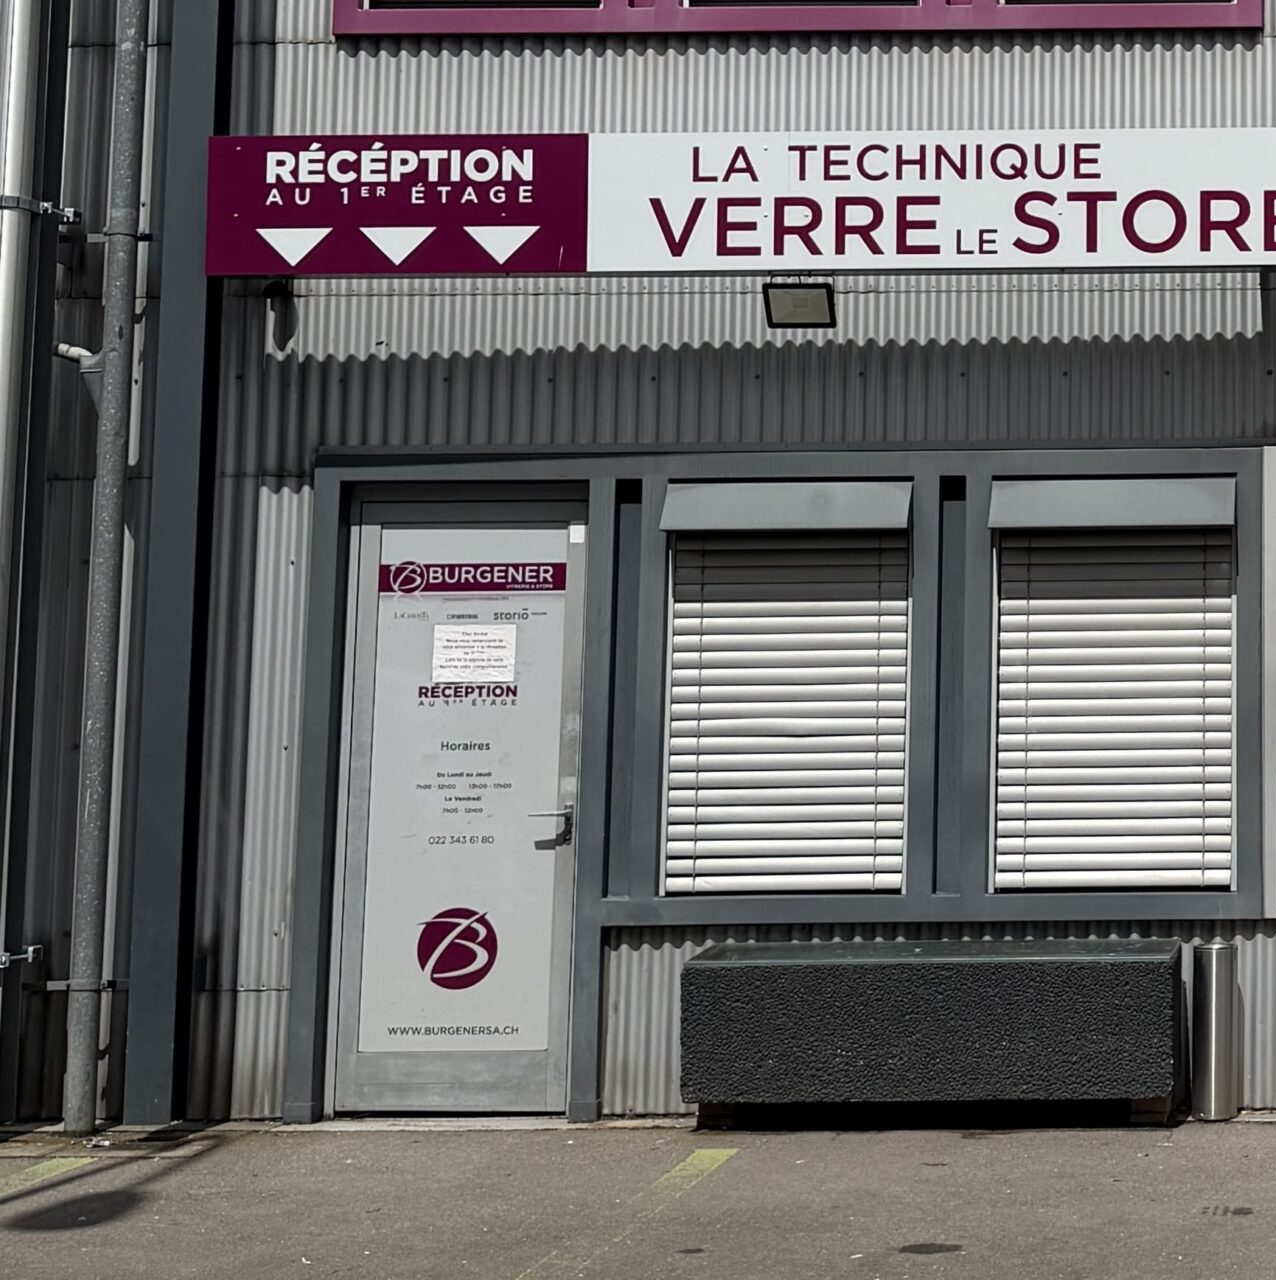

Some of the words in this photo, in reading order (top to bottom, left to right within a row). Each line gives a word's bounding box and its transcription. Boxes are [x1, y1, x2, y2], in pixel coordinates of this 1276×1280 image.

[265, 141, 534, 185] RÉCÉPTION
[691, 145, 760, 184] LA
[786, 142, 1102, 182] TECHNIQUE
[264, 186, 312, 206] AU
[410, 182, 534, 205] ÉTAGE
[647, 195, 942, 258] VERRE
[955, 228, 999, 255] LE
[428, 565, 554, 584] BURGENER
[440, 741, 491, 751] Horaires
[428, 836, 447, 845] 022
[449, 835, 467, 844] 343
[469, 835, 480, 844] 61
[481, 835, 495, 844] 80
[387, 1026, 519, 1036] WWW.BURGENERSA.CH
